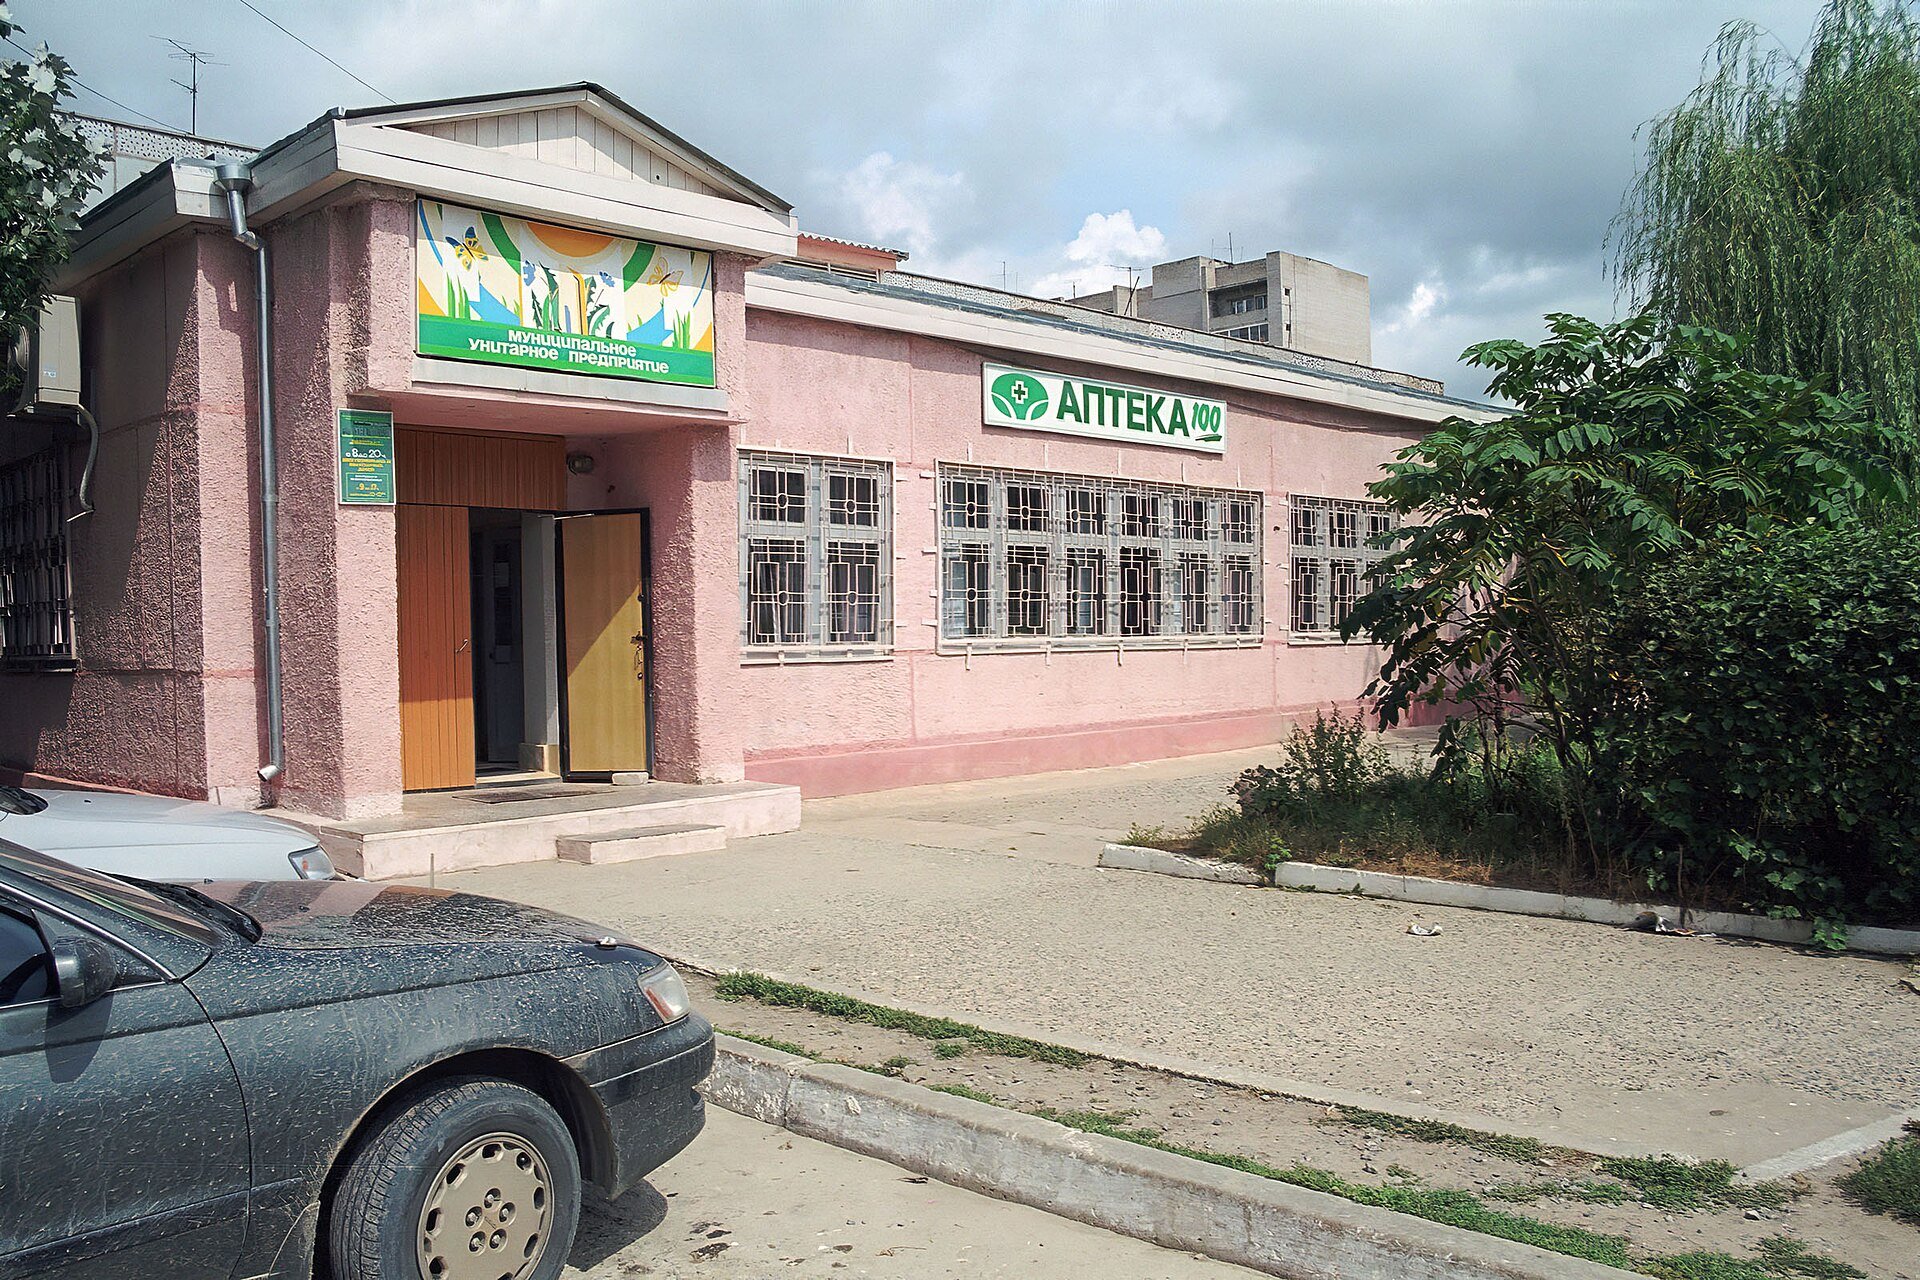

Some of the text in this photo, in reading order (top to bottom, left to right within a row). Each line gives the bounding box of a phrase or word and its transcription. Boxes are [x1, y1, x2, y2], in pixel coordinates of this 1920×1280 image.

[1056, 380, 1222, 437] АПТЕКА 100
[369, 449, 381, 458] 20
